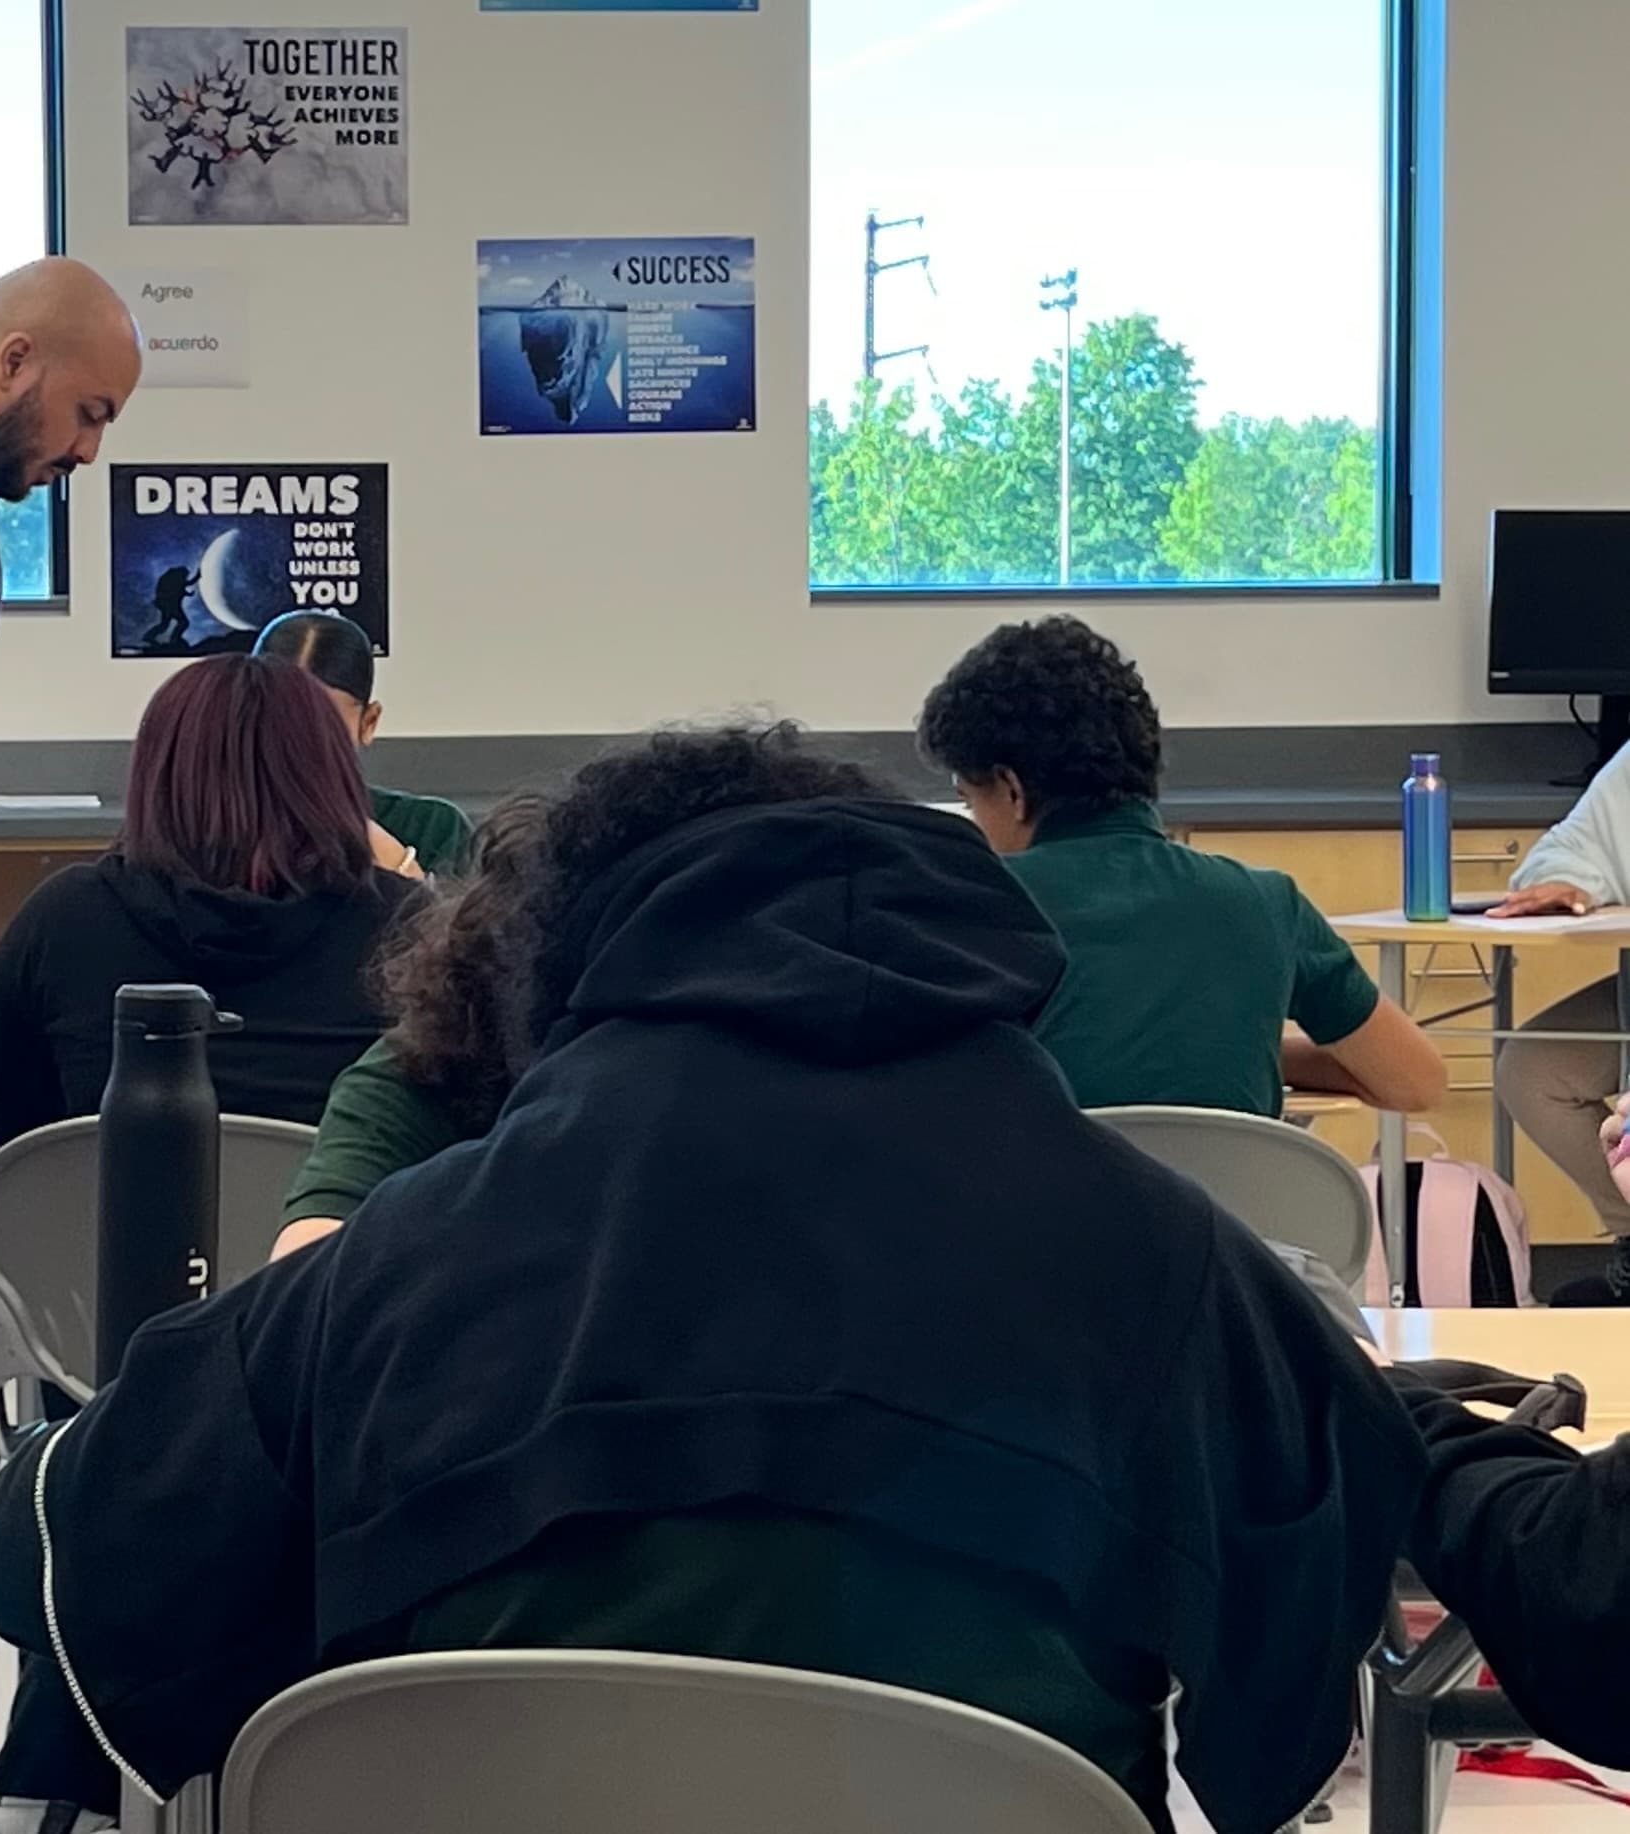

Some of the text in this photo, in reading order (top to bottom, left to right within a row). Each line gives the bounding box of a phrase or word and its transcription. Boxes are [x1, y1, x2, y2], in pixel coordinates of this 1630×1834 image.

[243, 39, 399, 76] TOGETHER
[285, 85, 399, 101] EVERYONE
[294, 107, 399, 123] ACHIEVES
[335, 129, 399, 145] MORE
[626, 255, 731, 284] SUCCESS
[141, 283, 194, 303] Agree
[148, 334, 219, 351] acuerdo
[135, 475, 360, 515] DREAMS
[294, 522, 356, 538] DON'T
[293, 541, 356, 557] WORK
[288, 560, 361, 576] UNLESS
[290, 581, 359, 605] YOU
